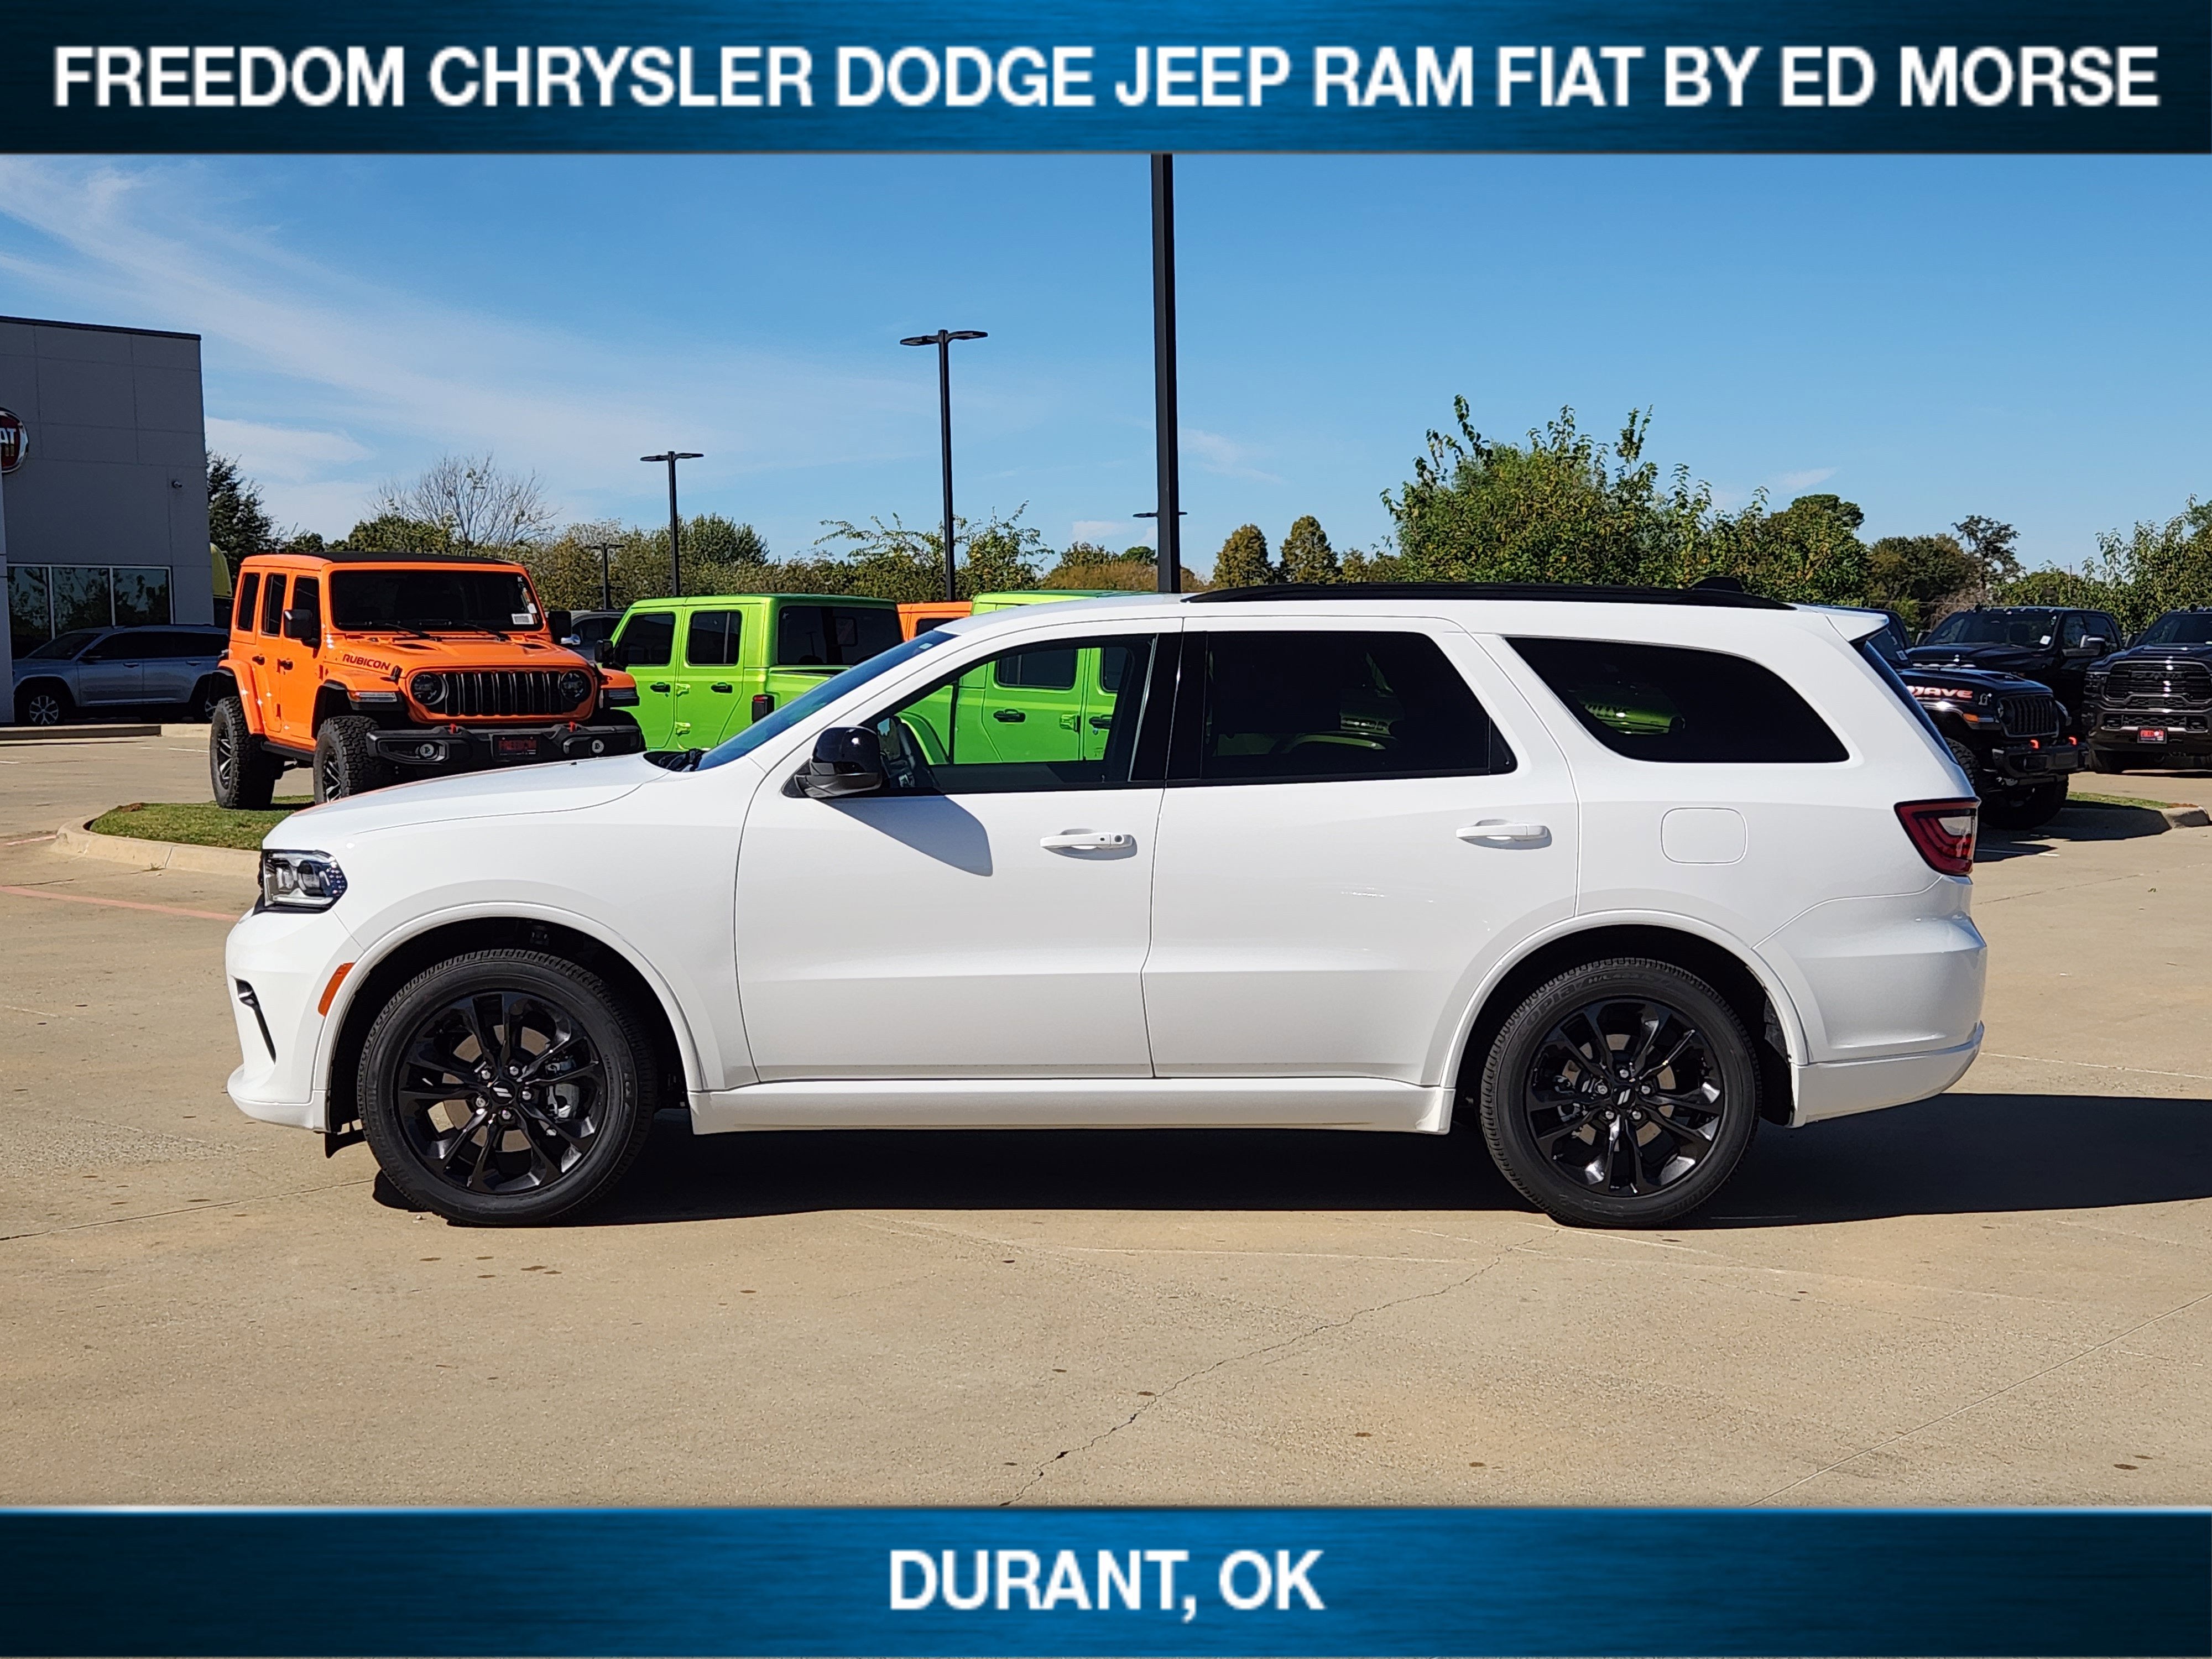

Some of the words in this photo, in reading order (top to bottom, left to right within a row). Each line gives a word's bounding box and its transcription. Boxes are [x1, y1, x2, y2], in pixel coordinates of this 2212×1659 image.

[0, 427, 17, 445] AT
[342, 654, 391, 671] RUBICON
[1906, 685, 1973, 698] JAVE
